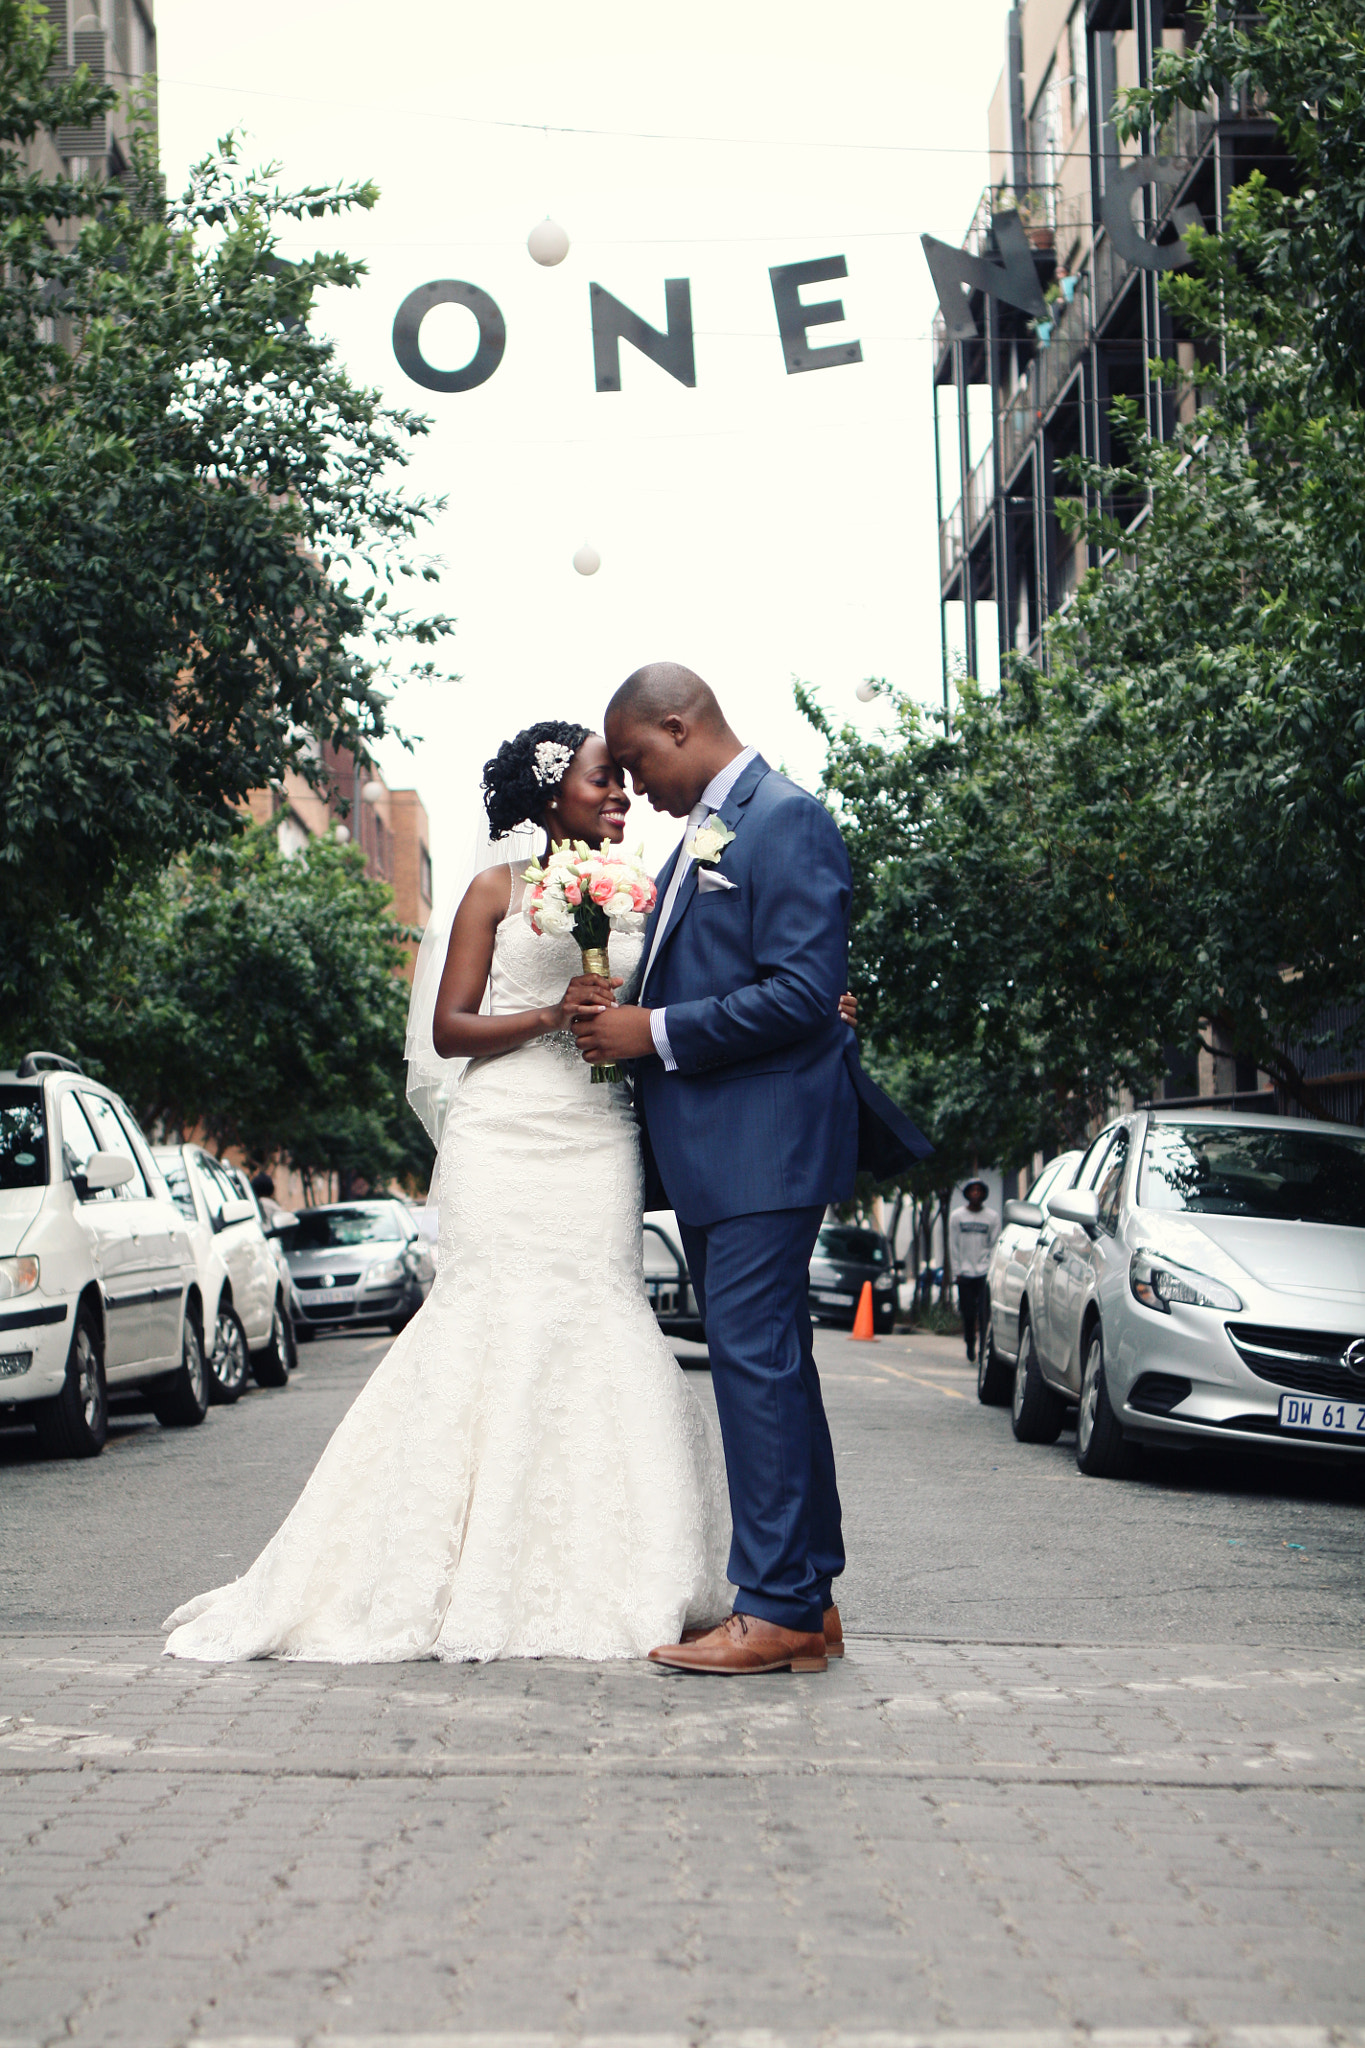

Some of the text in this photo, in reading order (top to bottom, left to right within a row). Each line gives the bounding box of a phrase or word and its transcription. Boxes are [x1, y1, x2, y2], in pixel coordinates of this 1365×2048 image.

[260, 154, 1209, 395] ONENG
[1287, 1400, 1313, 1424] DW
[1322, 1404, 1345, 1428] 61
